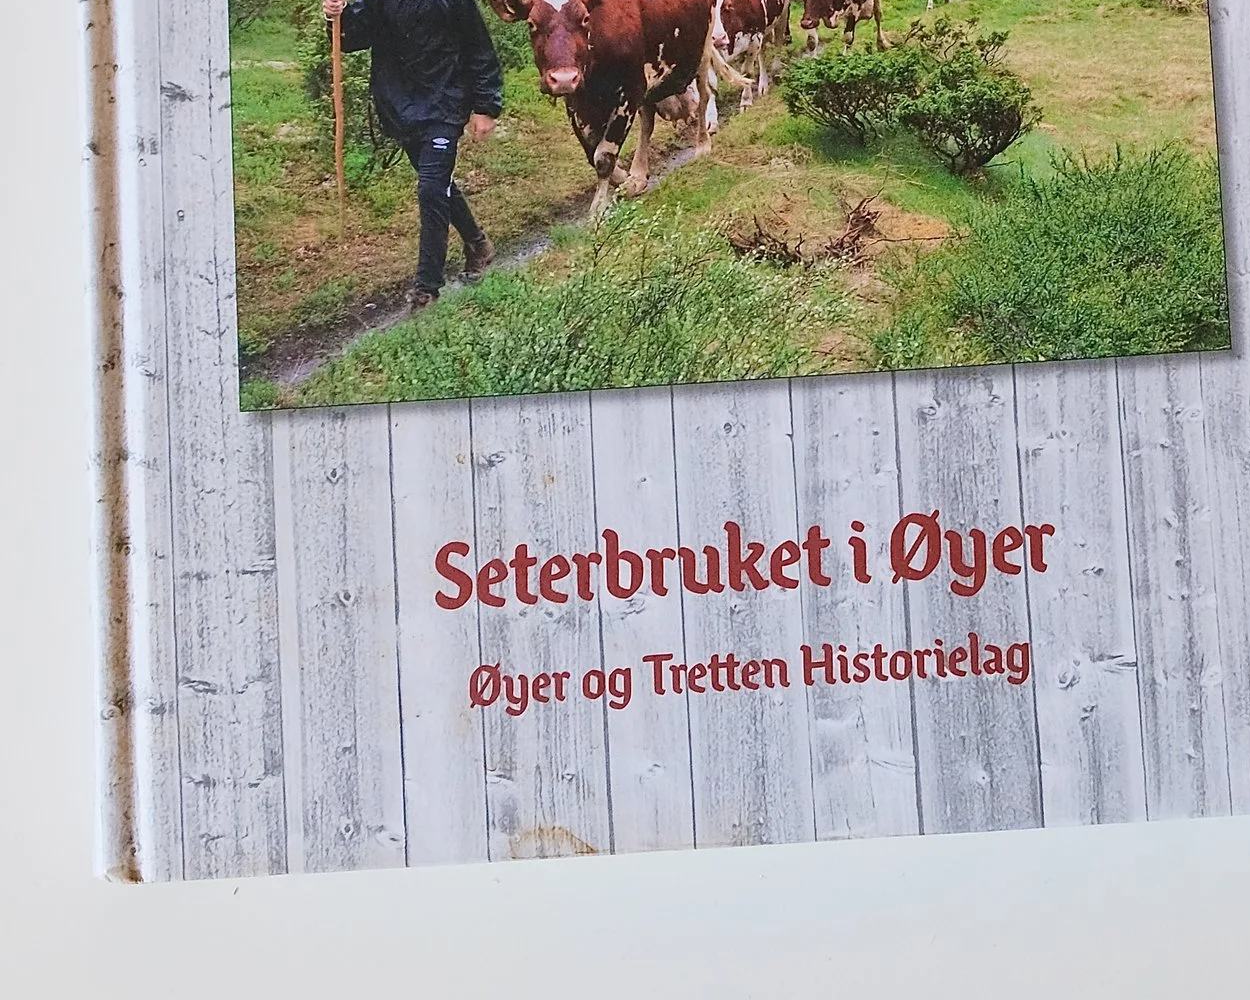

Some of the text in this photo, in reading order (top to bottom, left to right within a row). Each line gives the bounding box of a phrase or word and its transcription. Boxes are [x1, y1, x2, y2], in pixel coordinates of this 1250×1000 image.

[435, 510, 1055, 610] Seterbruket i Øyer
[469, 632, 1030, 716] Øyer og Tretten Historielag
